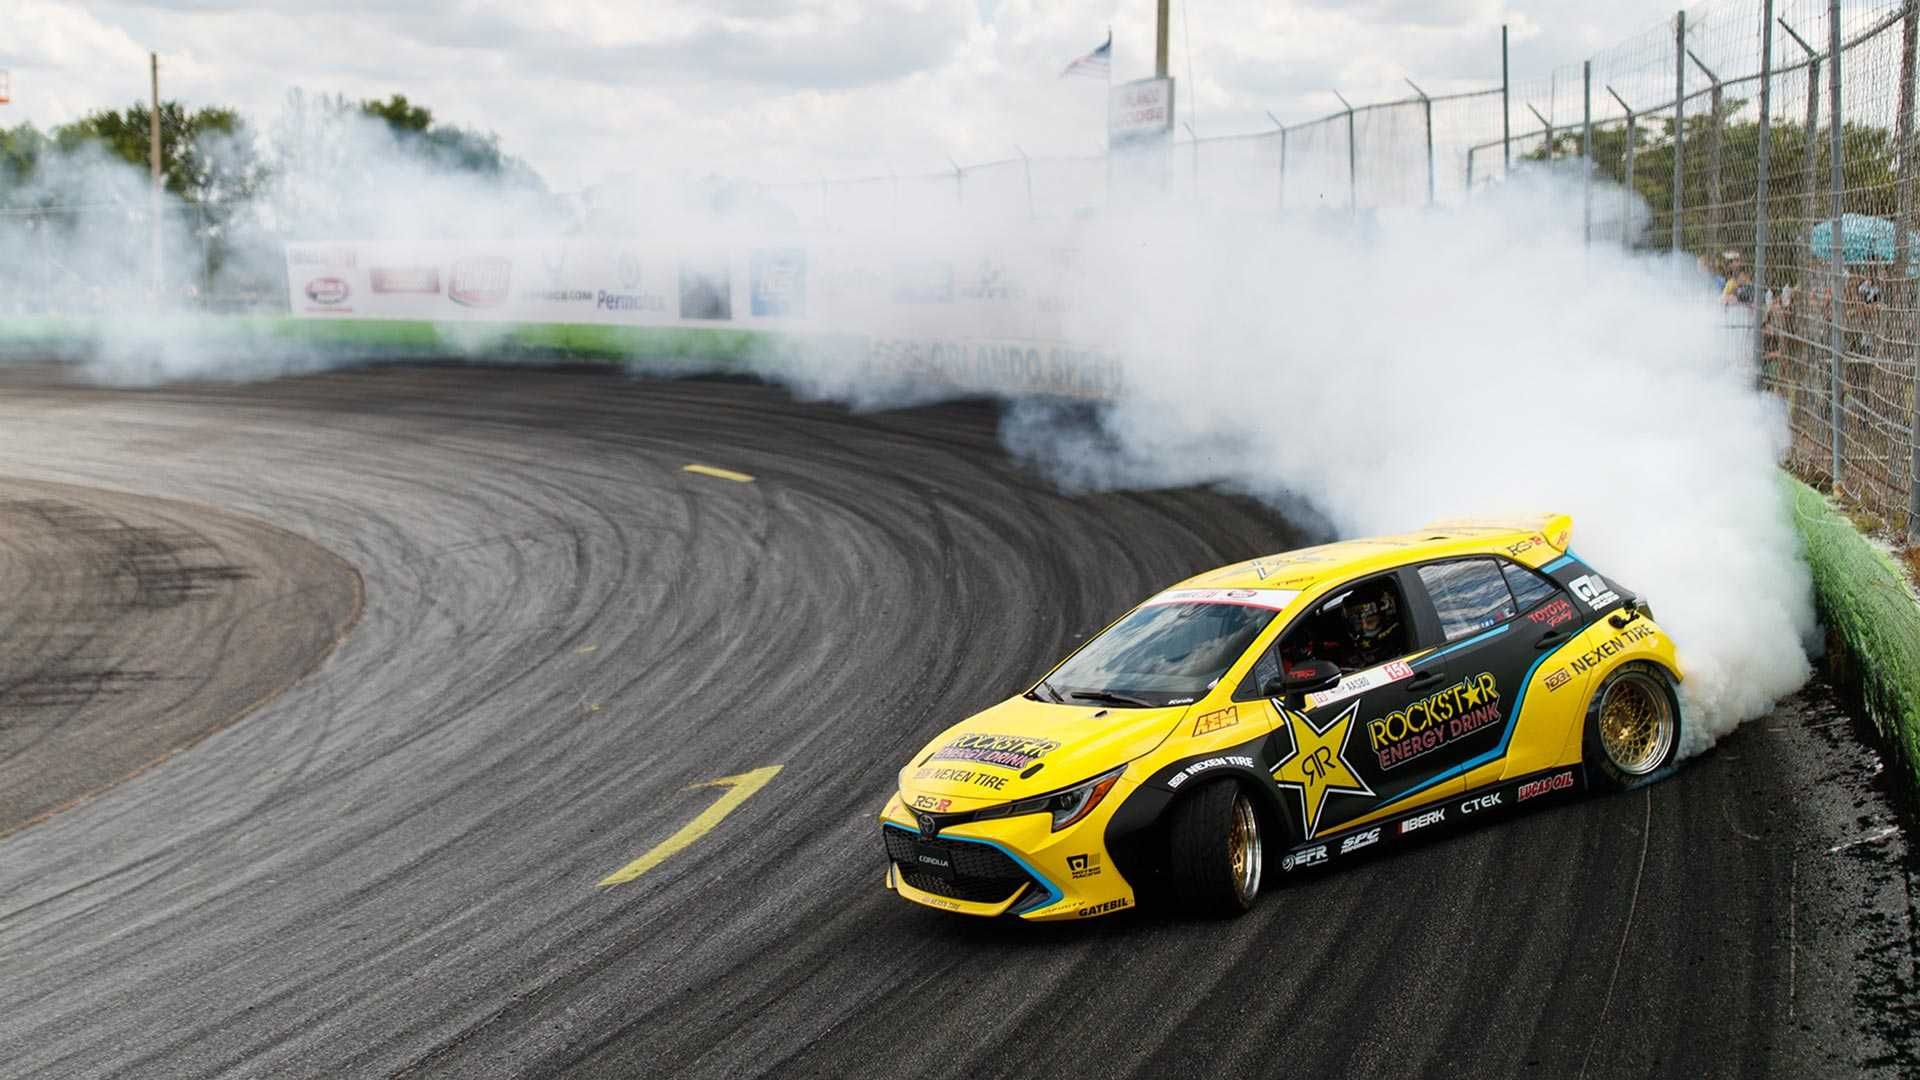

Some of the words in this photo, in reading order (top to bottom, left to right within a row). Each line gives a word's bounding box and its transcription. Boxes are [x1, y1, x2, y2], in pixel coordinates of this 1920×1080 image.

[1528, 599, 1569, 623] TOYOTA
[1570, 636, 1624, 675] NEXEN
[1621, 624, 1655, 644] TIRE
[1192, 705, 1239, 737] AEM
[1368, 673, 1499, 750] ROCKSTAR
[1379, 724, 1445, 767] ENERGY
[1449, 702, 1500, 738] DRINK
[984, 750, 1032, 769] DRINK
[1185, 757, 1226, 775] NEXEN
[1224, 756, 1254, 768] TIRE
[930, 768, 974, 783] NEXEN
[974, 772, 1008, 790] TIRE
[1518, 779, 1552, 802] LUCAS
[1551, 771, 1574, 791] OIL
[1461, 791, 1503, 815] CTEK
[1405, 807, 1447, 832] BERK
[1341, 827, 1382, 850] SPC
[918, 855, 949, 868] COROLLA
[1295, 845, 1329, 866] EFR
[1078, 897, 1129, 917] GATEBIL
